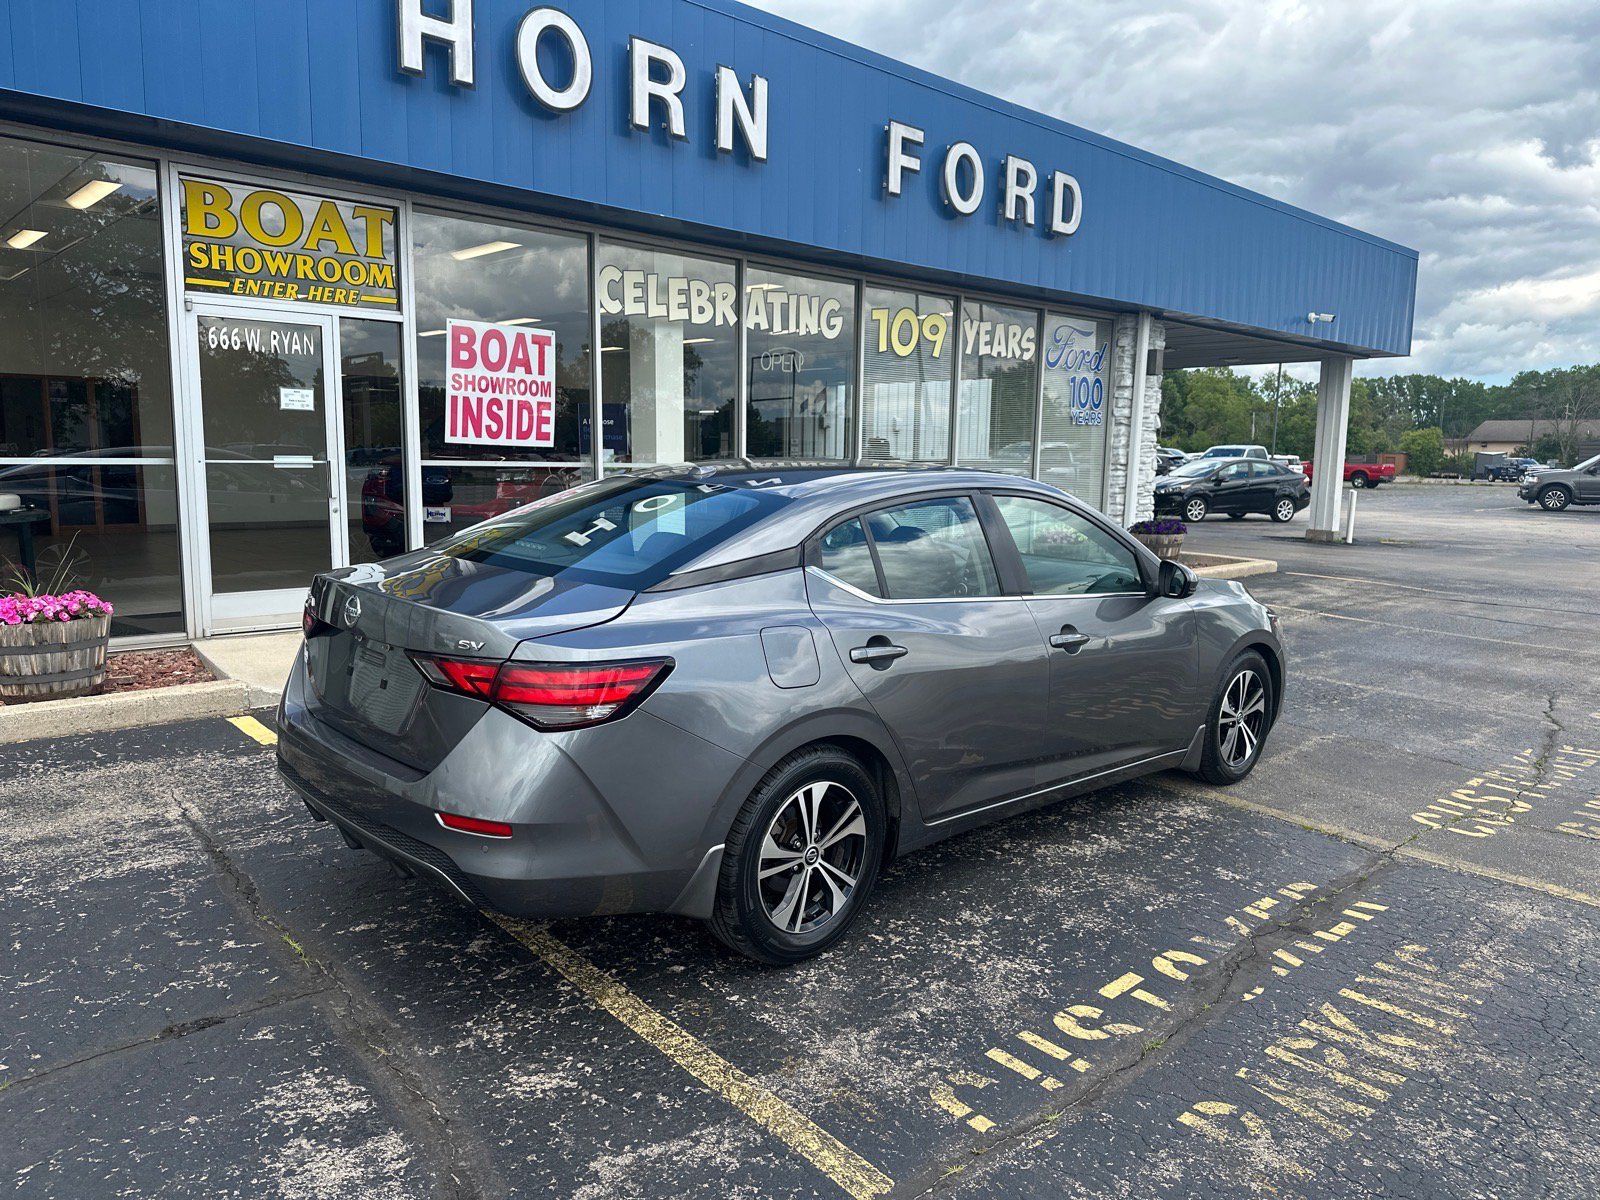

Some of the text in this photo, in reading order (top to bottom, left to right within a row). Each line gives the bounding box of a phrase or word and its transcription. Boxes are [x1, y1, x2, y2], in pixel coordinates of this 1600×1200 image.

[398, 0, 1083, 236] HORN FORD
[181, 178, 394, 259] BOAT
[188, 242, 396, 289] SHOWROOM
[232, 277, 360, 305] ENTER HERE
[600, 264, 843, 340] CELEBRATING
[208, 326, 314, 356] 666 W. RYAN
[451, 324, 552, 377] BOAT
[871, 306, 948, 359] 109
[963, 318, 1036, 361] YEARS
[1046, 324, 1107, 372] Ford
[760, 351, 803, 373] OPEN
[451, 373, 552, 398] SHOWROOM
[1069, 375, 1104, 410] 100
[450, 395, 552, 442] INSIDE
[1071, 410, 1103, 426] YEARS
[457, 639, 486, 651] SV
